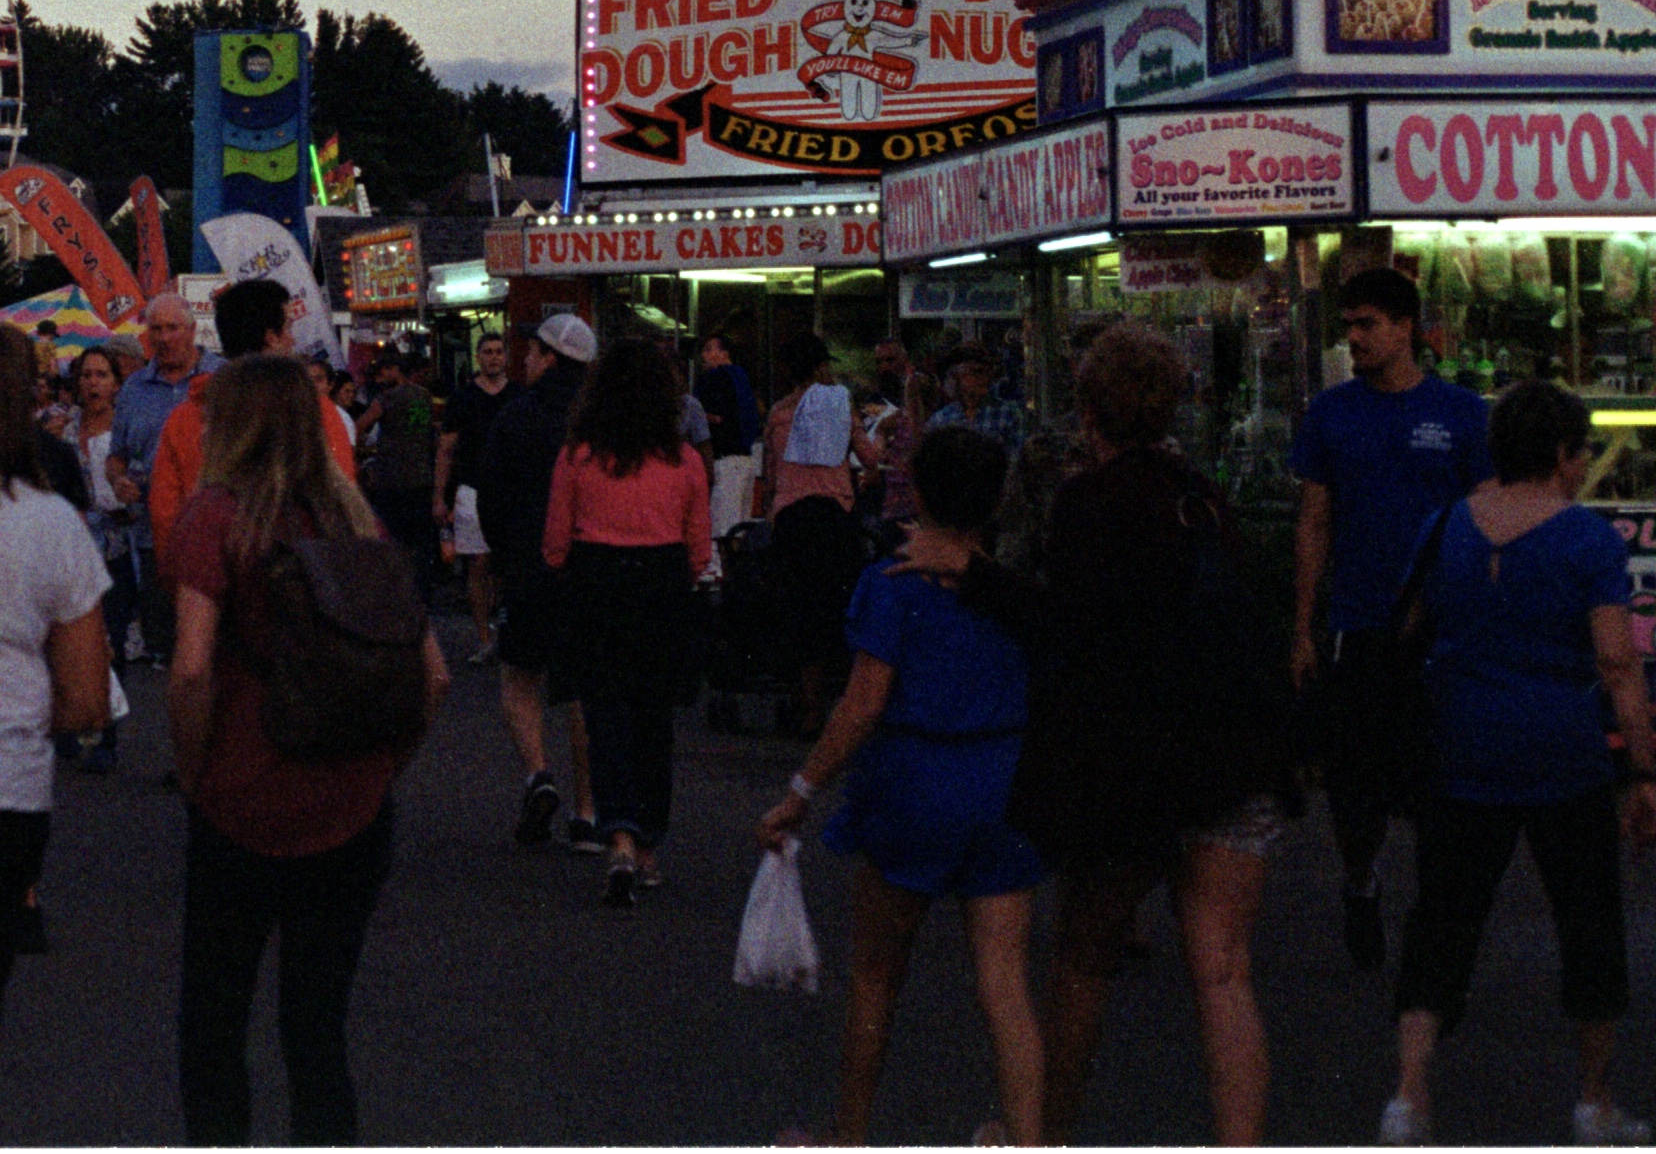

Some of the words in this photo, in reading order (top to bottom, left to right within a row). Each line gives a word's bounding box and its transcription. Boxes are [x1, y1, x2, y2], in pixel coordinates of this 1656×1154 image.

[814, 3, 839, 22] TRY
[1529, 0, 1598, 24] Serving
[1546, 29, 1600, 49] Smith
[582, 25, 793, 109] DOUGH
[805, 57, 850, 80] YOU'LL
[852, 59, 882, 81] LIKE
[719, 115, 862, 163] FRIED
[1127, 134, 1157, 154] Ice
[1161, 117, 1206, 140] Cold
[1210, 114, 1248, 131] and
[1253, 113, 1344, 149] Delicious
[1395, 112, 1656, 204] COTTON
[986, 147, 1039, 236] CANDY
[1043, 131, 1107, 226] APPLES
[1134, 190, 1157, 204] All
[1161, 190, 1199, 205] your
[1204, 187, 1269, 202] favorite
[1274, 184, 1337, 199] Flavors
[37, 197, 99, 272] FRYS
[528, 230, 663, 264] FUNNEL
[676, 225, 784, 260] CAKES
